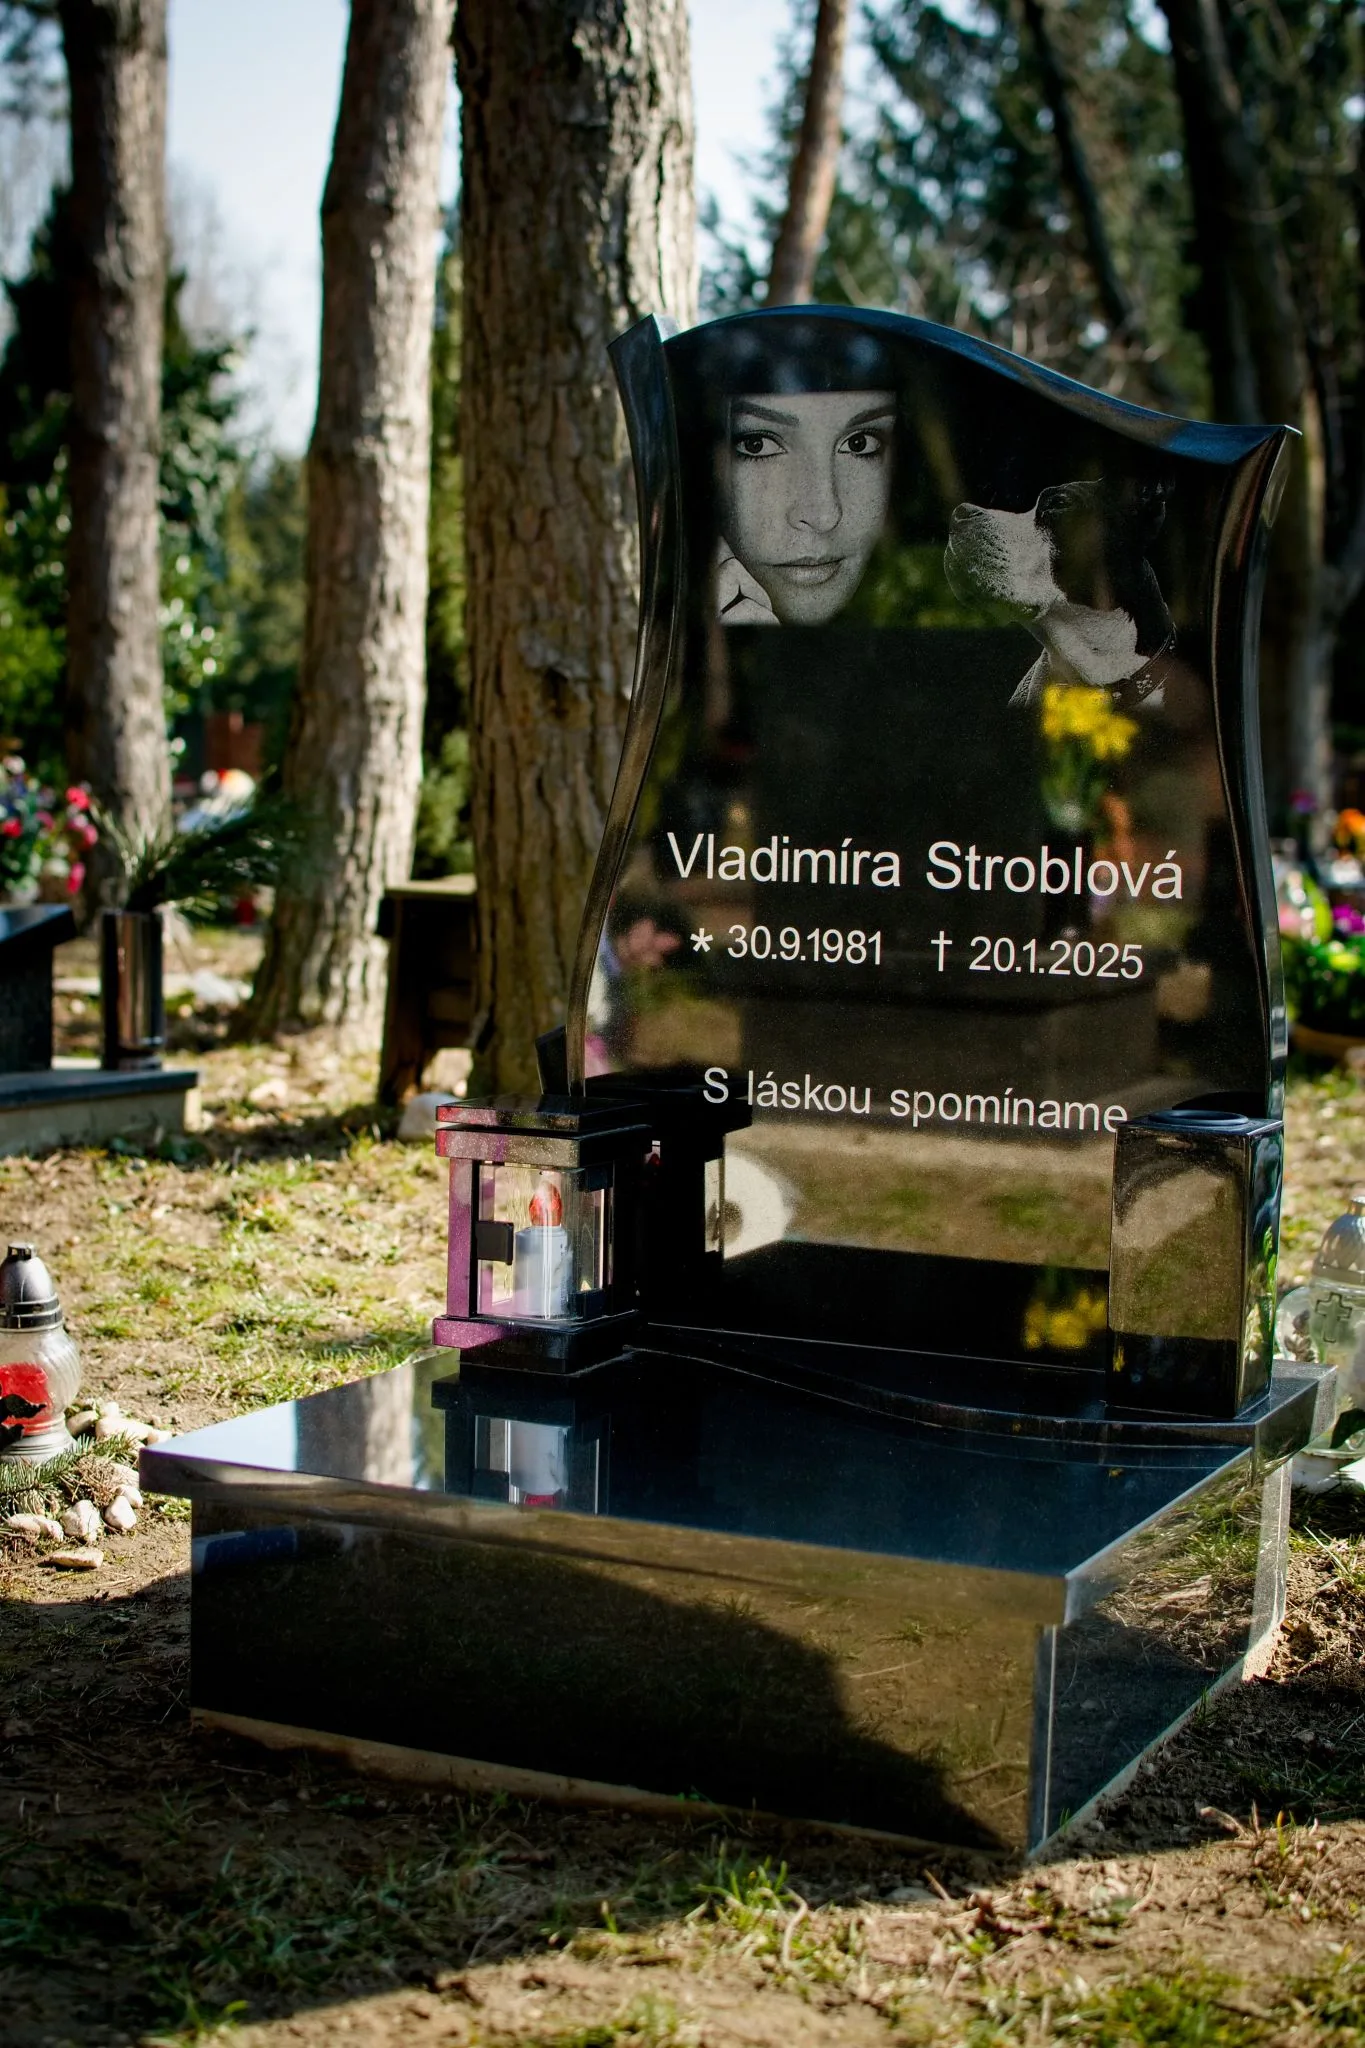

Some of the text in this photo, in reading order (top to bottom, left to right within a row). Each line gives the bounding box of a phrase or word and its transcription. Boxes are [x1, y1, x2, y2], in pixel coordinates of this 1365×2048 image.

[667, 832, 1183, 900] Vladimíra Stroblová
[727, 924, 1143, 979] 30.9.1981 20.1.2025
[703, 1067, 1128, 1133] S láskou spomíname
